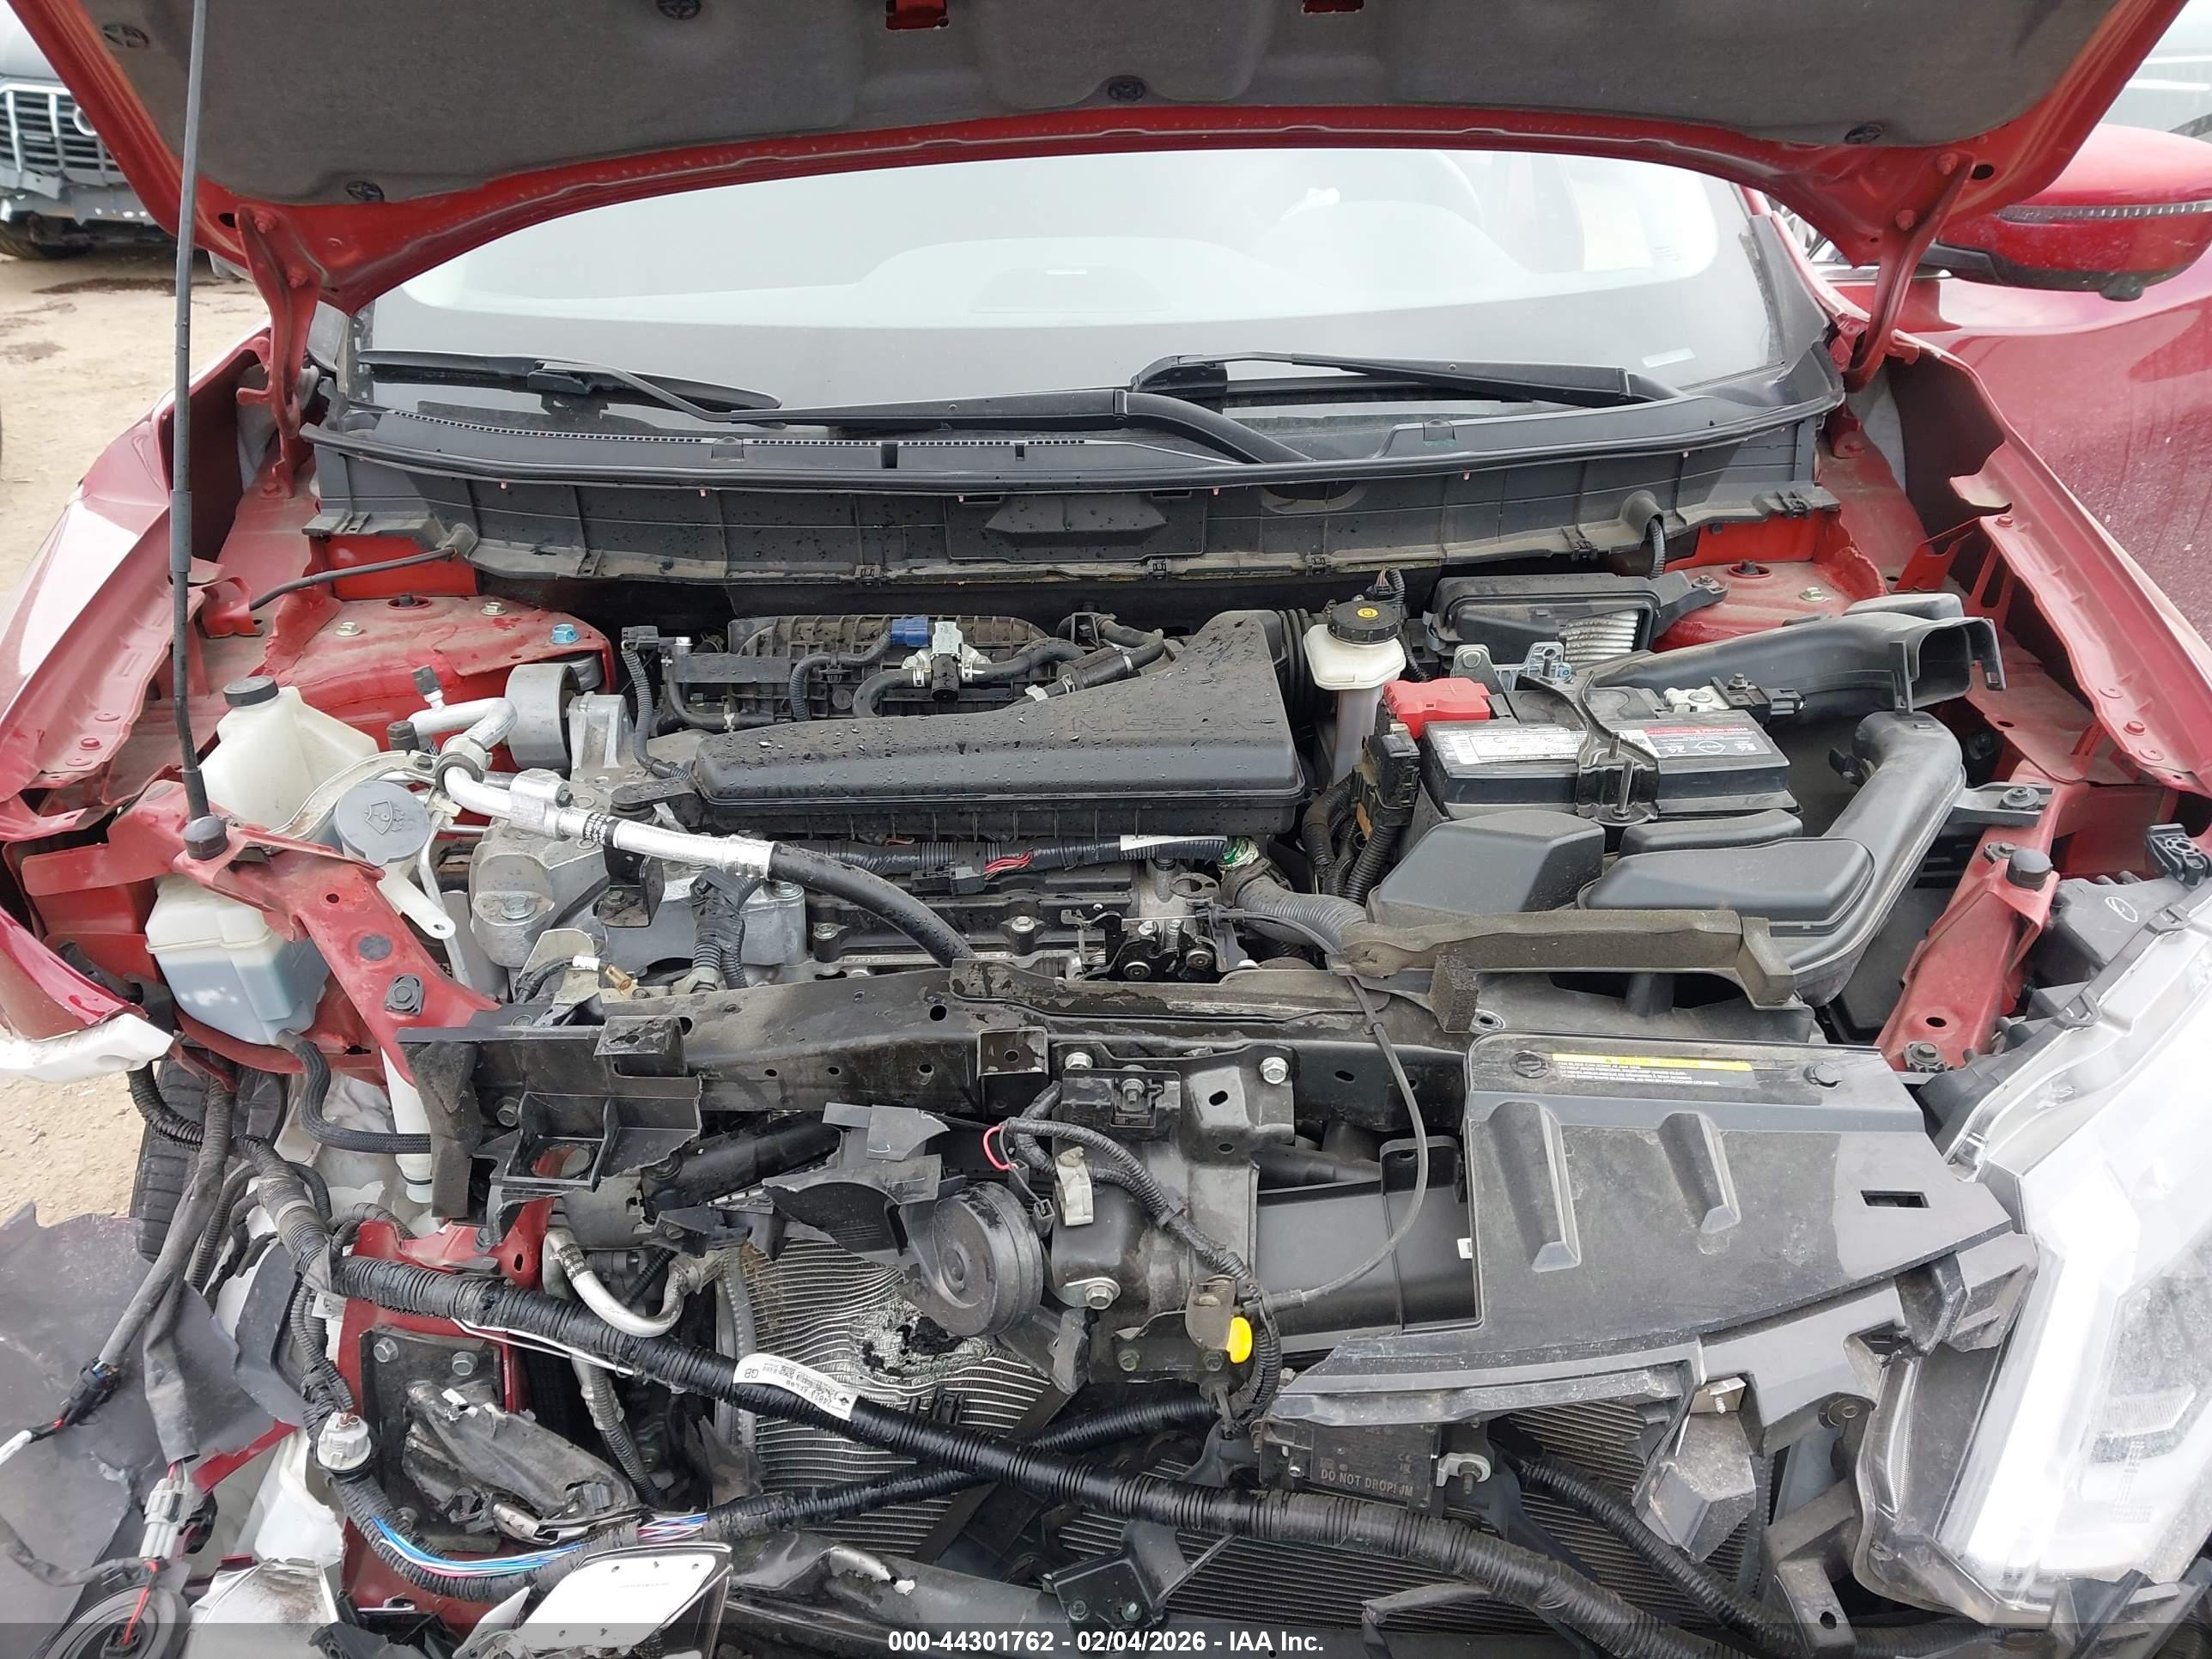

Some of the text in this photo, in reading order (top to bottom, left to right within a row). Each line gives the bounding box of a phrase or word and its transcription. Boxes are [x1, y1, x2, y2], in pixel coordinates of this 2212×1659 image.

[1321, 1469, 1336, 1481] DO
[1340, 1473, 1361, 1486] NOT
[1364, 1477, 1397, 1494] DROP!
